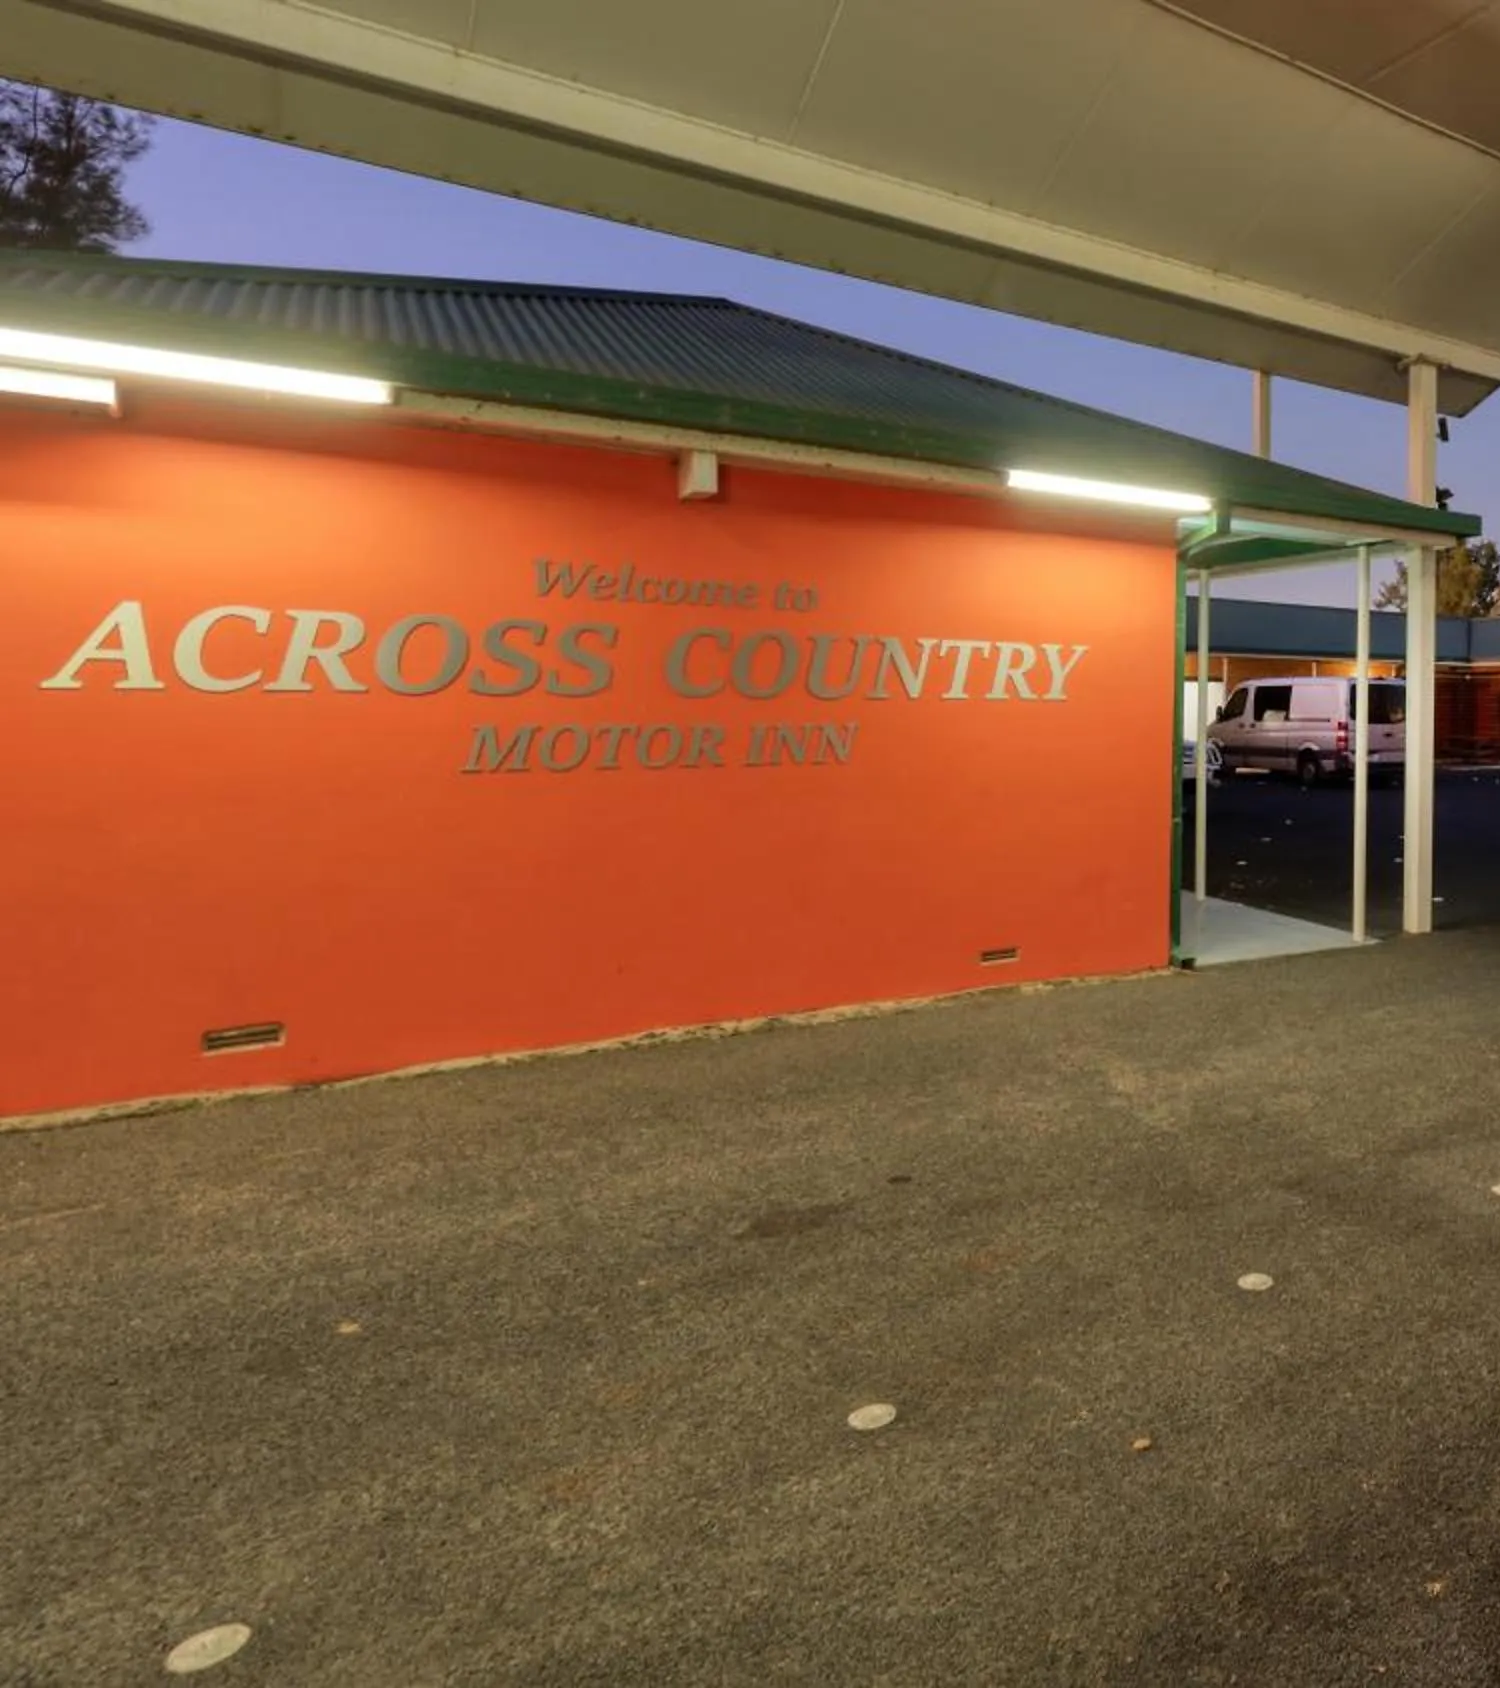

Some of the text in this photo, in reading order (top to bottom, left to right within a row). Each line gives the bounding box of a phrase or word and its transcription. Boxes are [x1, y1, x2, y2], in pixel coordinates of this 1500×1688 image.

[534, 557, 820, 613] Welcome to
[36, 599, 1088, 702] ACROSS COUNTRY
[459, 720, 860, 773] MOTOR INN
